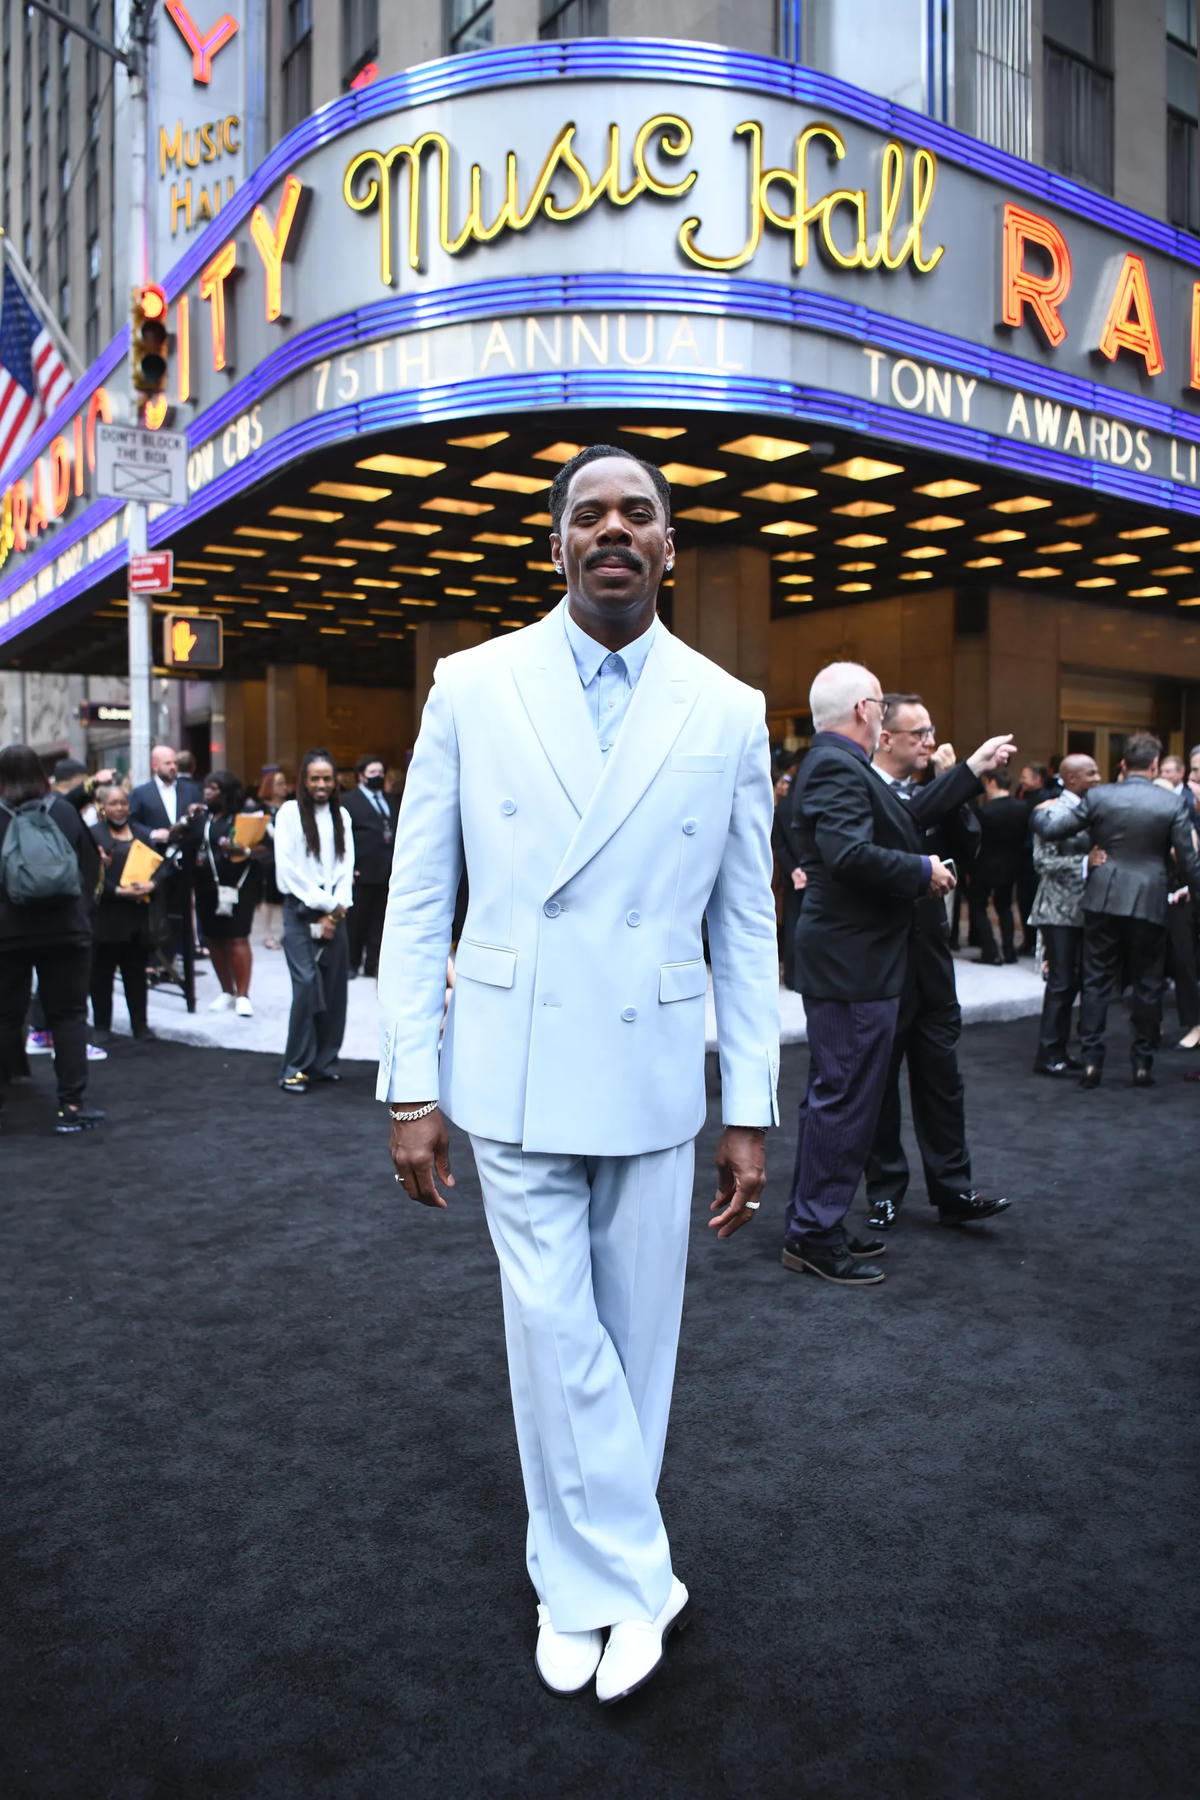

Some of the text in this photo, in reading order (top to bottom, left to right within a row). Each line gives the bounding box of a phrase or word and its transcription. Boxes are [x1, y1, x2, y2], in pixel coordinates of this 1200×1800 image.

[160, 116, 240, 176] MUSIC
[1002, 200, 1200, 391] RA
[313, 333, 430, 410] 75TH
[480, 314, 744, 373] ANNUAL
[864, 347, 977, 423] TONY
[1007, 392, 1153, 473] AWARDS
[117, 446, 168, 464] THE BOX
[141, 432, 182, 449] BLOCK
[188, 404, 264, 491] ON CBS
